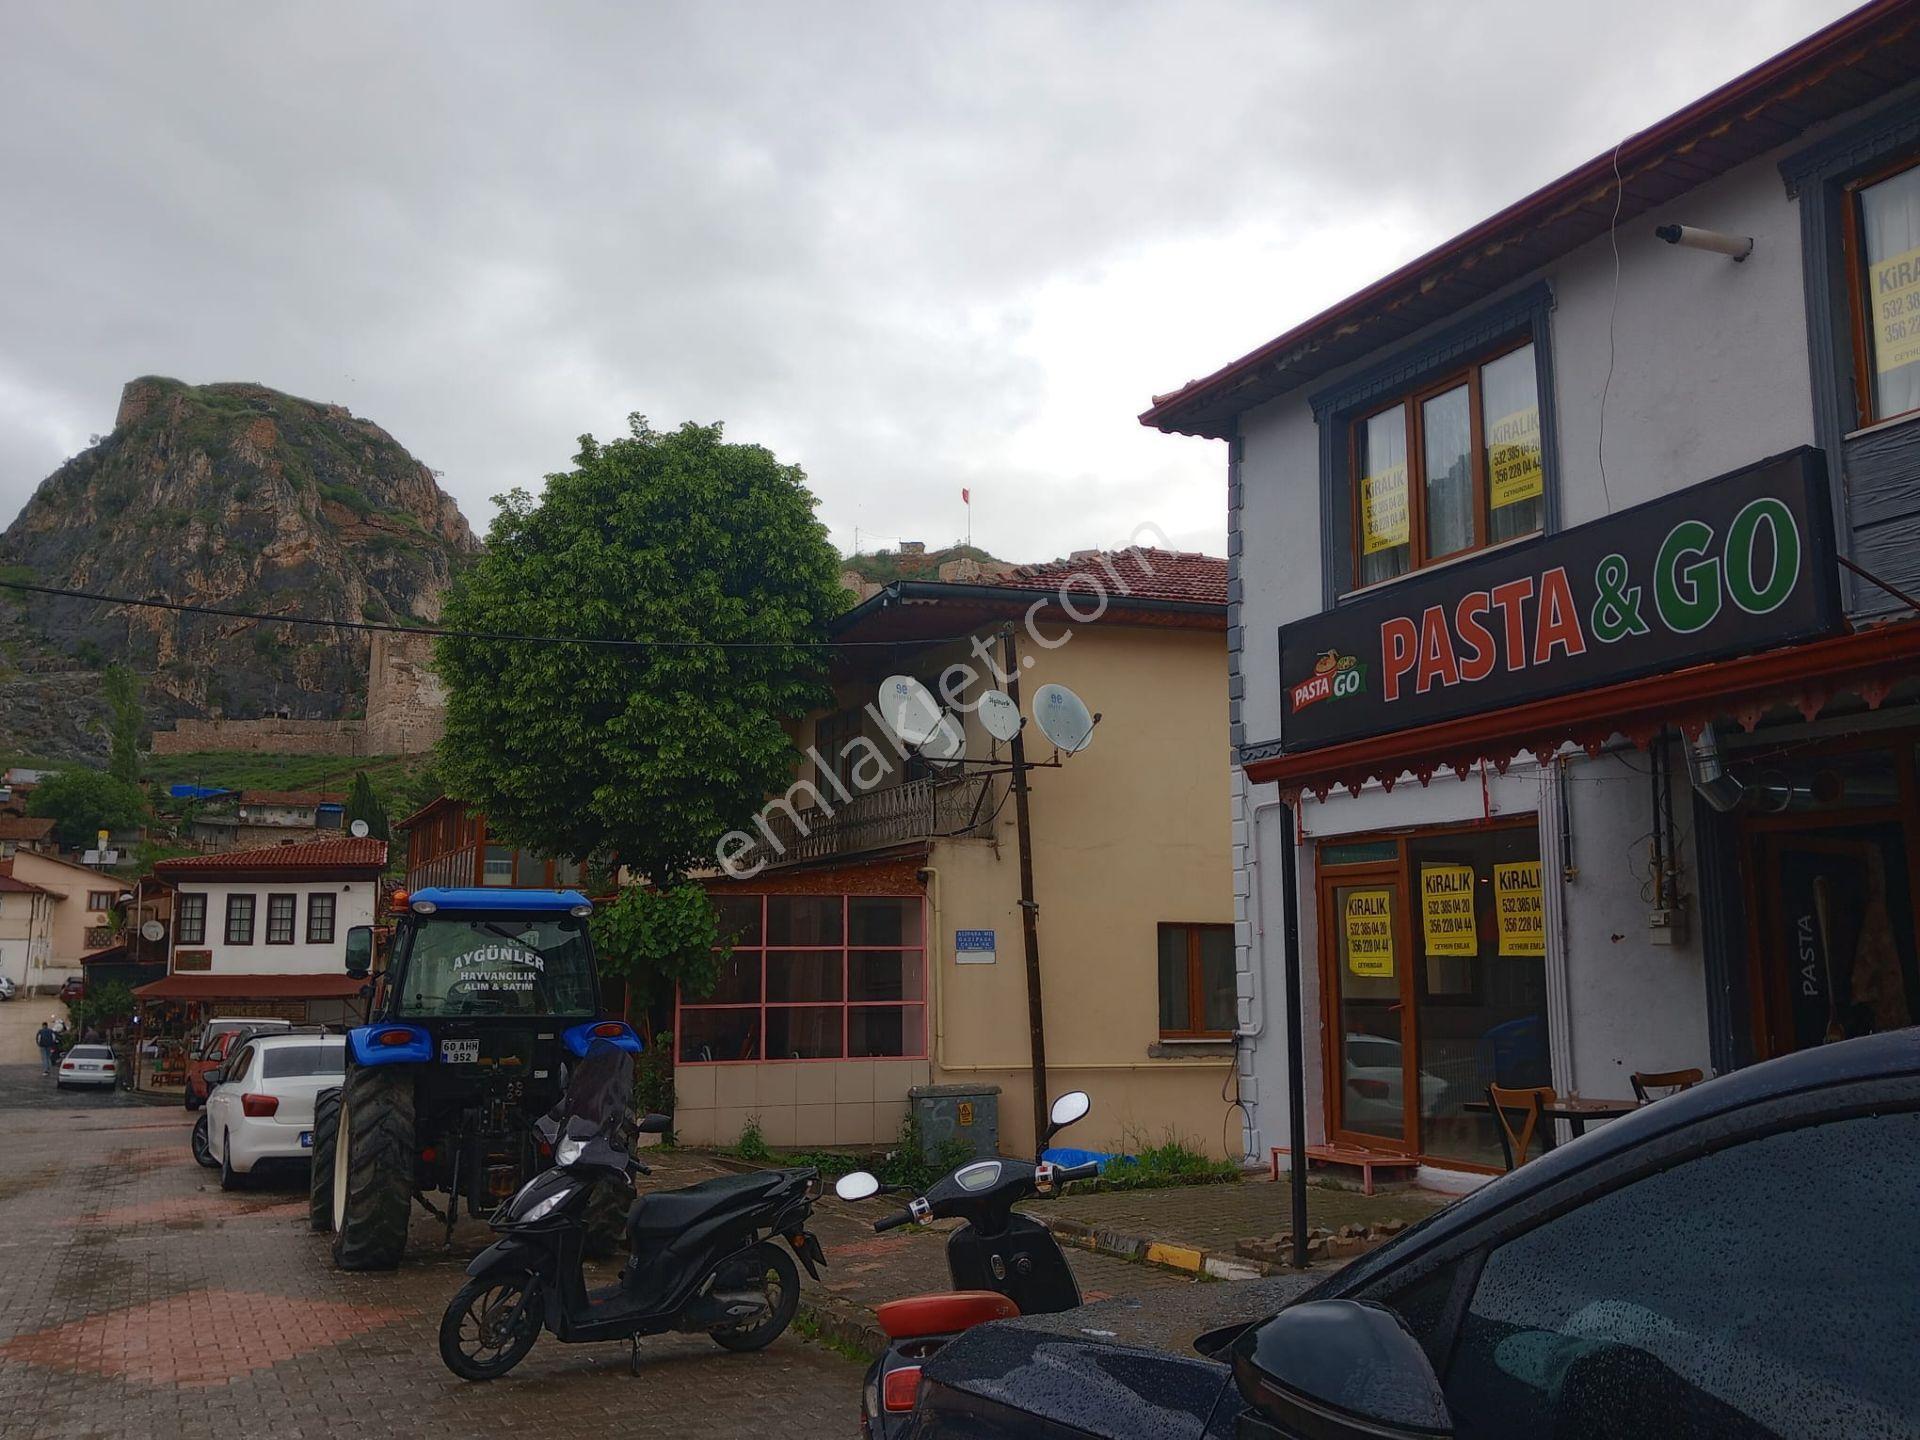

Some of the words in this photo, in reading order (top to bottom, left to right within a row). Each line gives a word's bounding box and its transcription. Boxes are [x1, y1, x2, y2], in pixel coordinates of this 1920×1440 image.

[1882, 297, 1904, 320] 532
[1884, 320, 1906, 343] 356
[1494, 450, 1506, 466] 532
[1507, 444, 1520, 461] 385
[1495, 468, 1508, 485] 356
[1508, 463, 1522, 480] 228
[1522, 459, 1532, 475] 04
[1380, 566, 1587, 702] PASTA
[1591, 553, 1650, 643] &
[1653, 497, 1800, 634] GO
[1295, 677, 1330, 707] PASTA
[1333, 670, 1360, 697] GO
[1428, 900, 1440, 915] 532
[1440, 899, 1453, 914] 385
[1452, 898, 1461, 913] 04
[1461, 898, 1470, 913] 20
[1502, 898, 1517, 913] 532
[1517, 897, 1531, 912] 385
[1531, 896, 1541, 912] 04
[1350, 922, 1360, 936] 532
[1360, 922, 1371, 936] 385
[1371, 922, 1380, 935] 04
[1380, 922, 1387, 935] 20
[1429, 919, 1442, 933] 356
[1441, 918, 1454, 933] 228
[1454, 917, 1463, 932] 04
[1464, 916, 1472, 932] 44
[1503, 917, 1518, 933] 356
[1518, 916, 1532, 932] 228
[1532, 916, 1542, 931] 04
[1352, 939, 1362, 953] 356
[1362, 939, 1373, 953] 228
[1373, 939, 1381, 953] 04
[1382, 938, 1390, 953] 44
[453, 944, 544, 972] AYGÜNLER
[1797, 915, 1818, 996] PASTA
[460, 972, 537, 981] HAYVANCILIK
[463, 983, 489, 991] ALIM
[491, 983, 499, 991] &
[503, 983, 533, 991] SATIM
[443, 1042, 456, 1051] 60
[459, 1041, 478, 1051] AHH
[453, 1053, 471, 1062] 952
